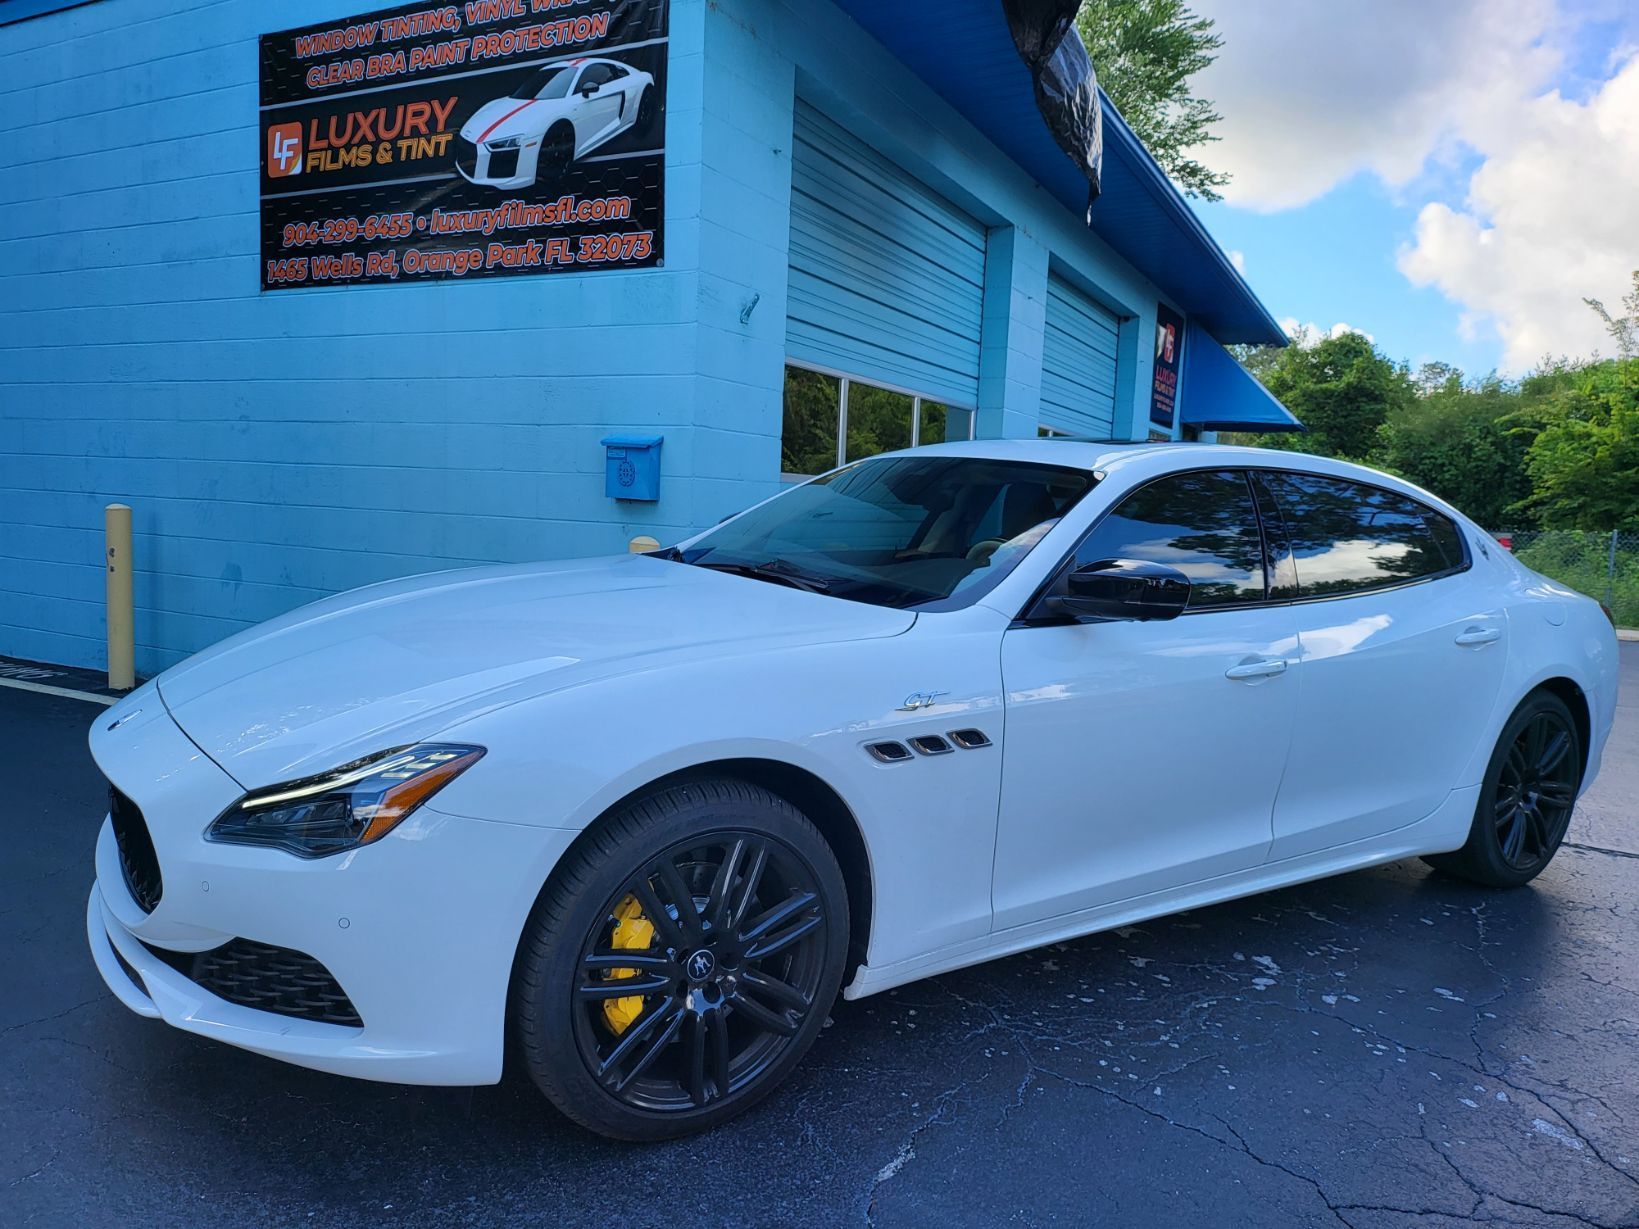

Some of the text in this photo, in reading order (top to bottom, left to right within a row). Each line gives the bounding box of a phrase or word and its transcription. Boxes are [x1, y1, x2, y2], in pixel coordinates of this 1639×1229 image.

[295, 0, 526, 59] WINDOW TINTING, VINYL
[306, 12, 611, 90] CLEAR BRA PAINT PROTECTION
[308, 96, 459, 151] LUXURY
[305, 133, 453, 174] FILMS & TINT
[283, 196, 631, 247] 904-299-6455 luxuryfilmsfl.com
[268, 231, 653, 283] 1465 Wells Rd, Orange Park FL 32073
[894, 690, 951, 711] GT
